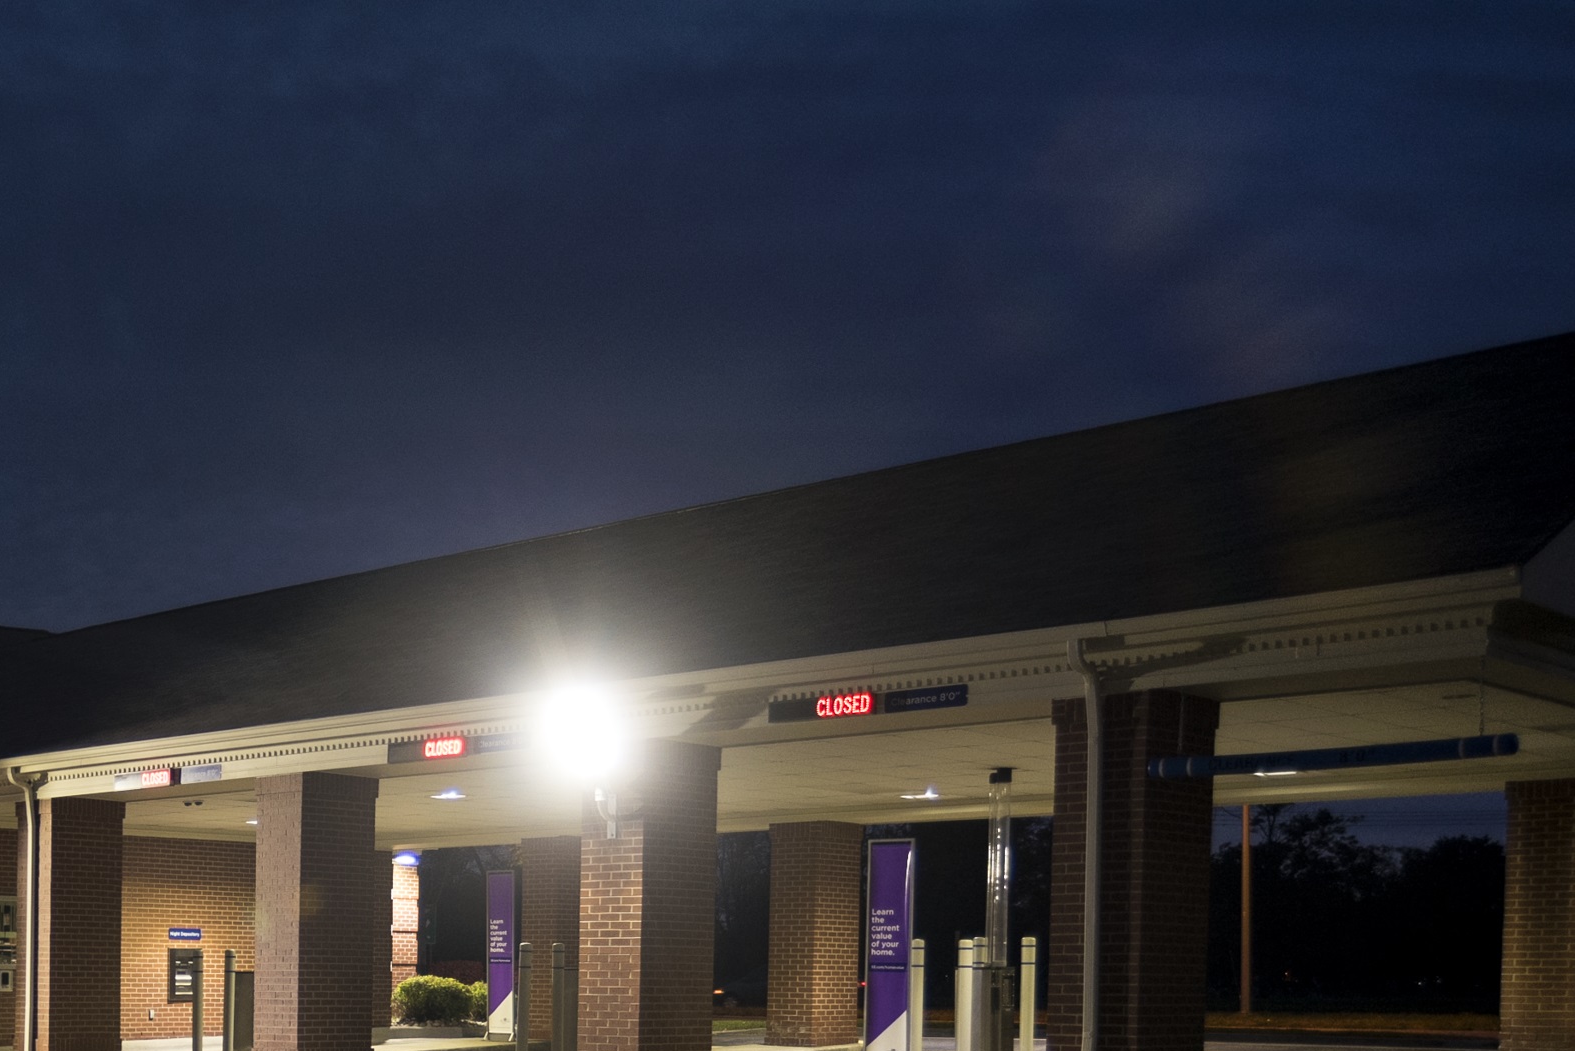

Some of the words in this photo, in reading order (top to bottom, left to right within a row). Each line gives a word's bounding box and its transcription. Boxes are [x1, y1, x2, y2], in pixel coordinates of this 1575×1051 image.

[816, 693, 872, 718] CLOSED
[890, 695, 937, 707] Clearance
[425, 738, 462, 757] CLOSED
[142, 771, 168, 786] CLOSED
[881, 941, 899, 949] your
